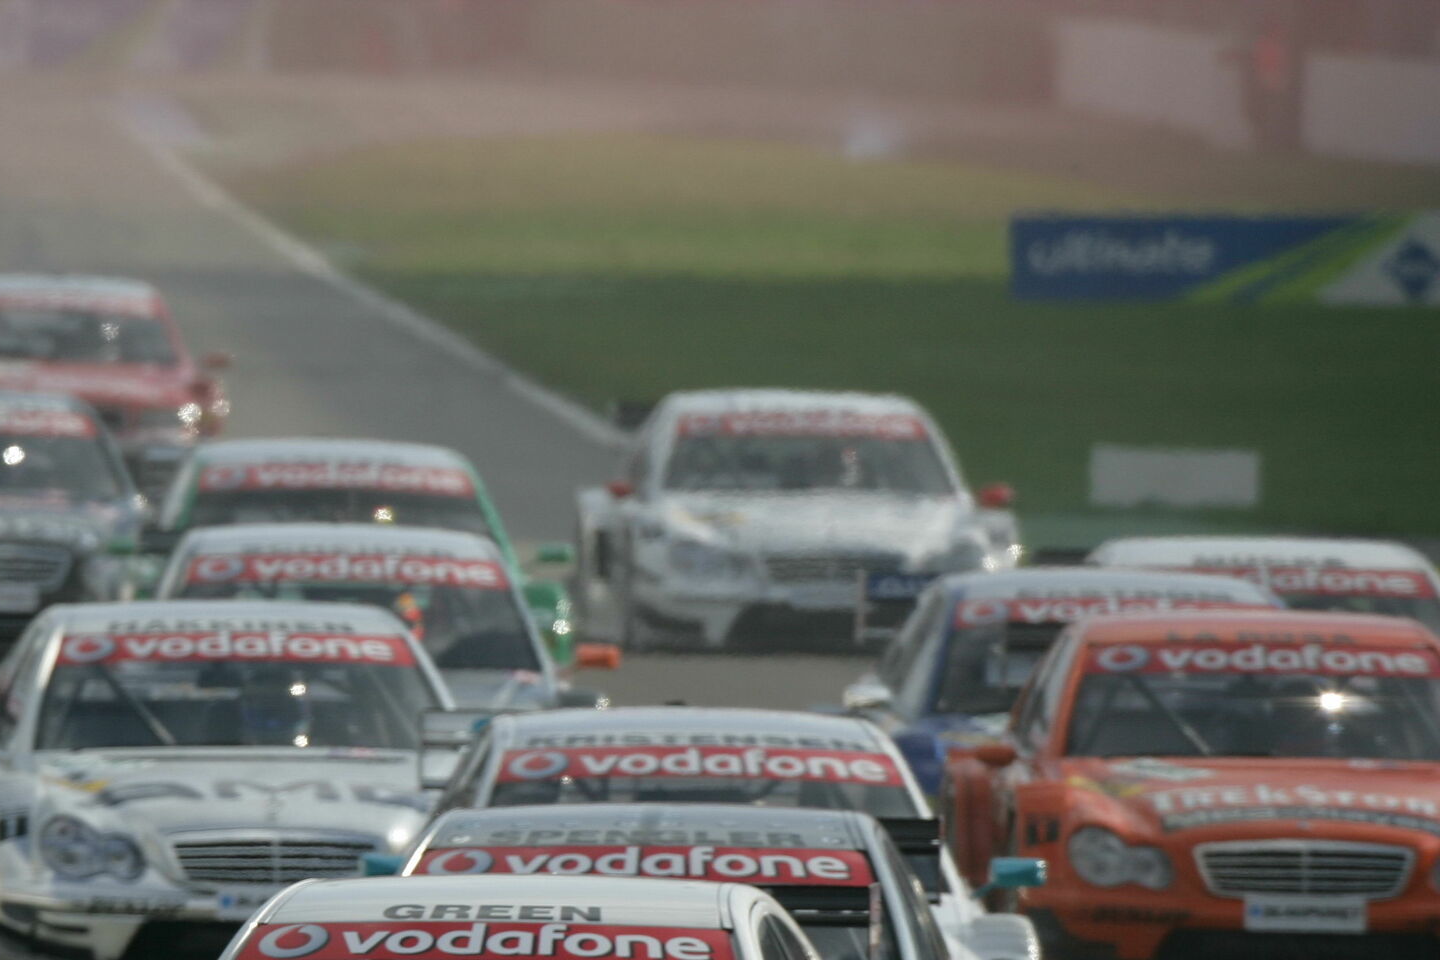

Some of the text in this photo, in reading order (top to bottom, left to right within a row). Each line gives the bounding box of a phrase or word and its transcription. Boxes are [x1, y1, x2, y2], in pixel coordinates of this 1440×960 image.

[253, 553, 498, 586] vodafone
[124, 631, 397, 662] vodafone
[1158, 644, 1434, 676] vodafone
[580, 747, 889, 783] vodafone
[485, 828, 806, 847] SPENGLER
[504, 846, 852, 880] vodafone
[382, 903, 603, 922] GREEN
